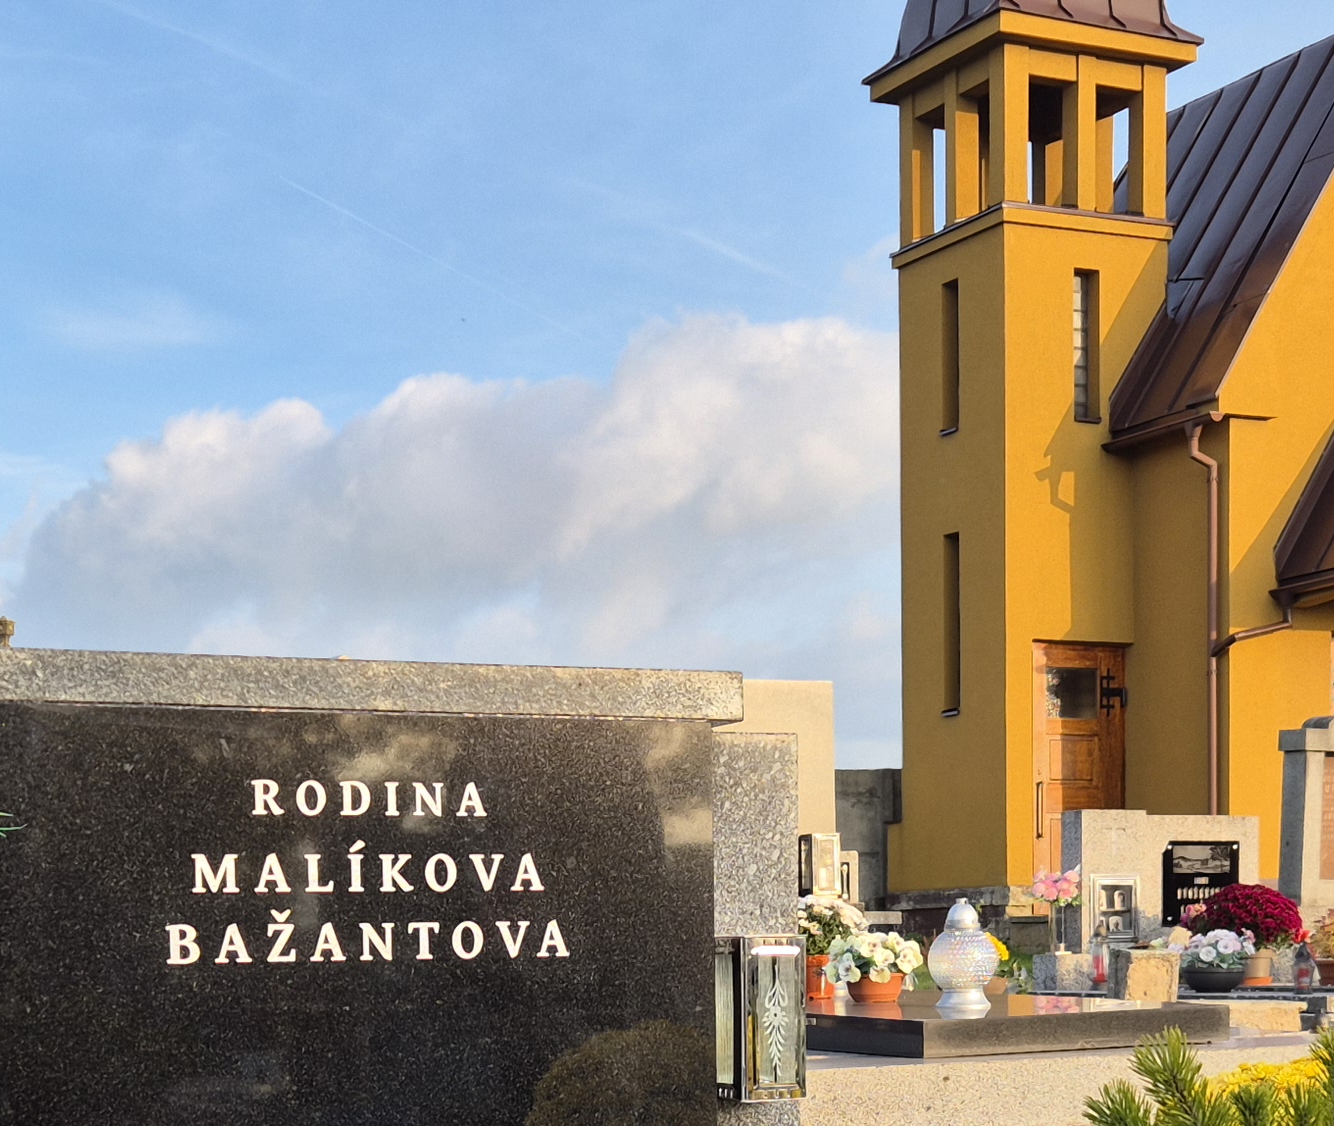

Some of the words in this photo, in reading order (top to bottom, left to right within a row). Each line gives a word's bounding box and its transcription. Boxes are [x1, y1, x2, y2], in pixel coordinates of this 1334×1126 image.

[250, 779, 488, 817] RODINA
[190, 839, 545, 893] MALÍKOVA
[165, 908, 571, 965] BAŽANTOVA
